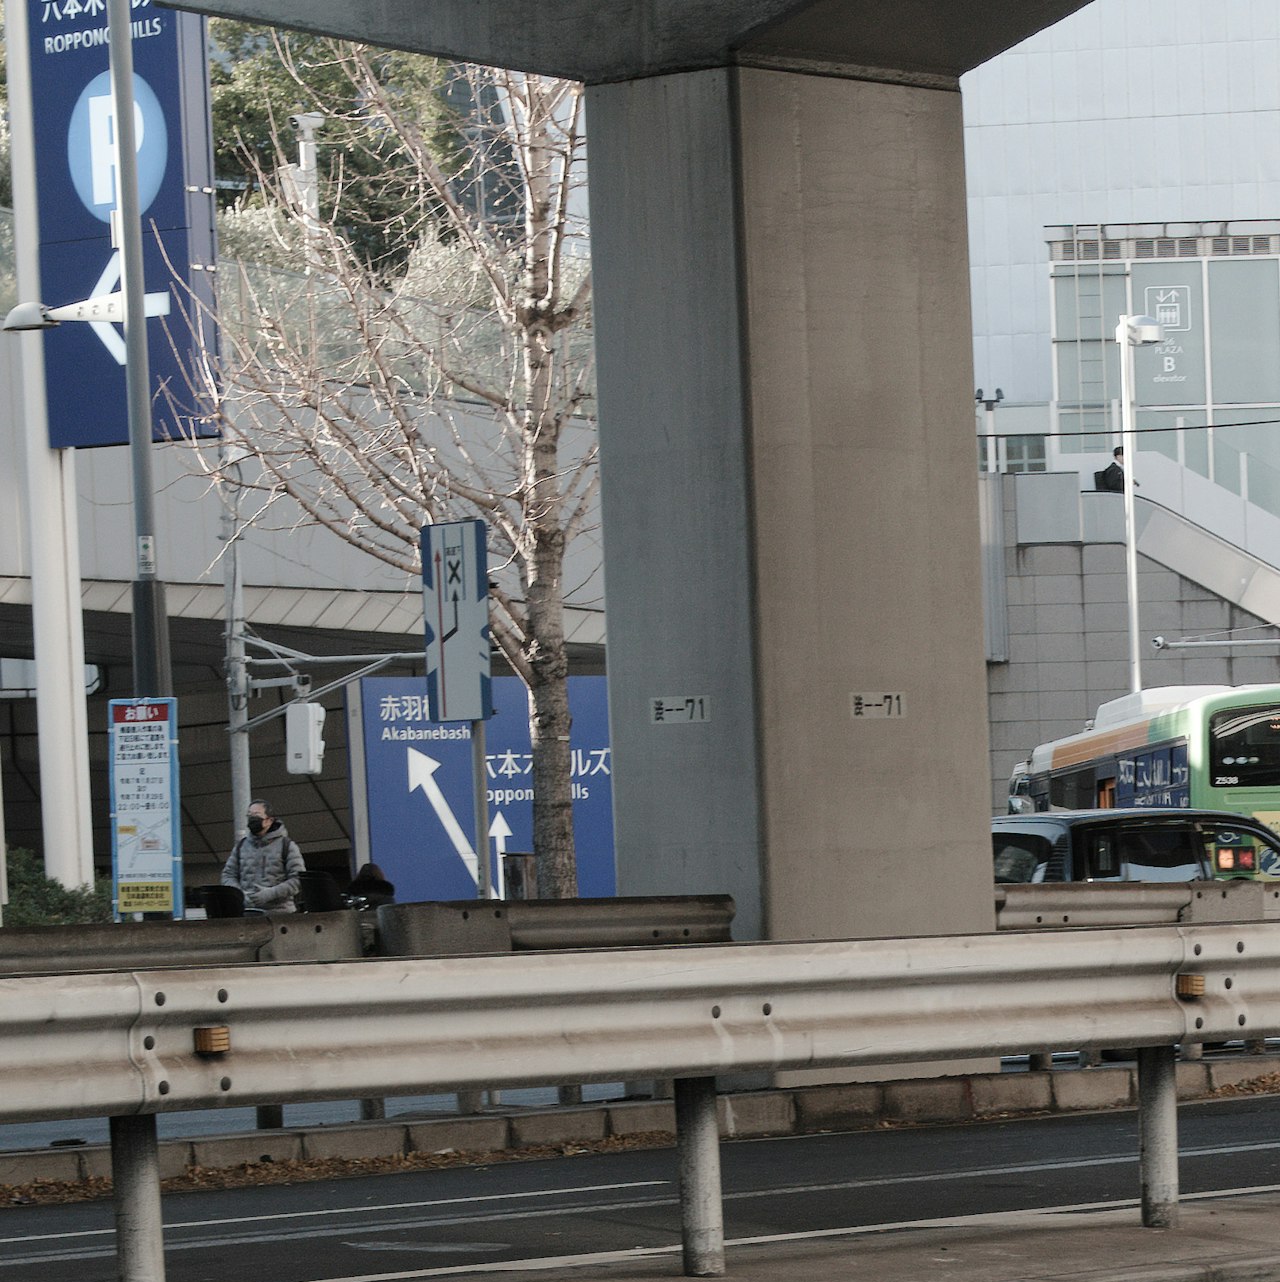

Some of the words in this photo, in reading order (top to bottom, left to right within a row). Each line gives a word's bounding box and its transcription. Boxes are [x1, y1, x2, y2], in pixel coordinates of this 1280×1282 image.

[1154, 346, 1184, 354] PLAZA
[1163, 356, 1175, 372] B
[381, 725, 472, 741] Akabanebash
